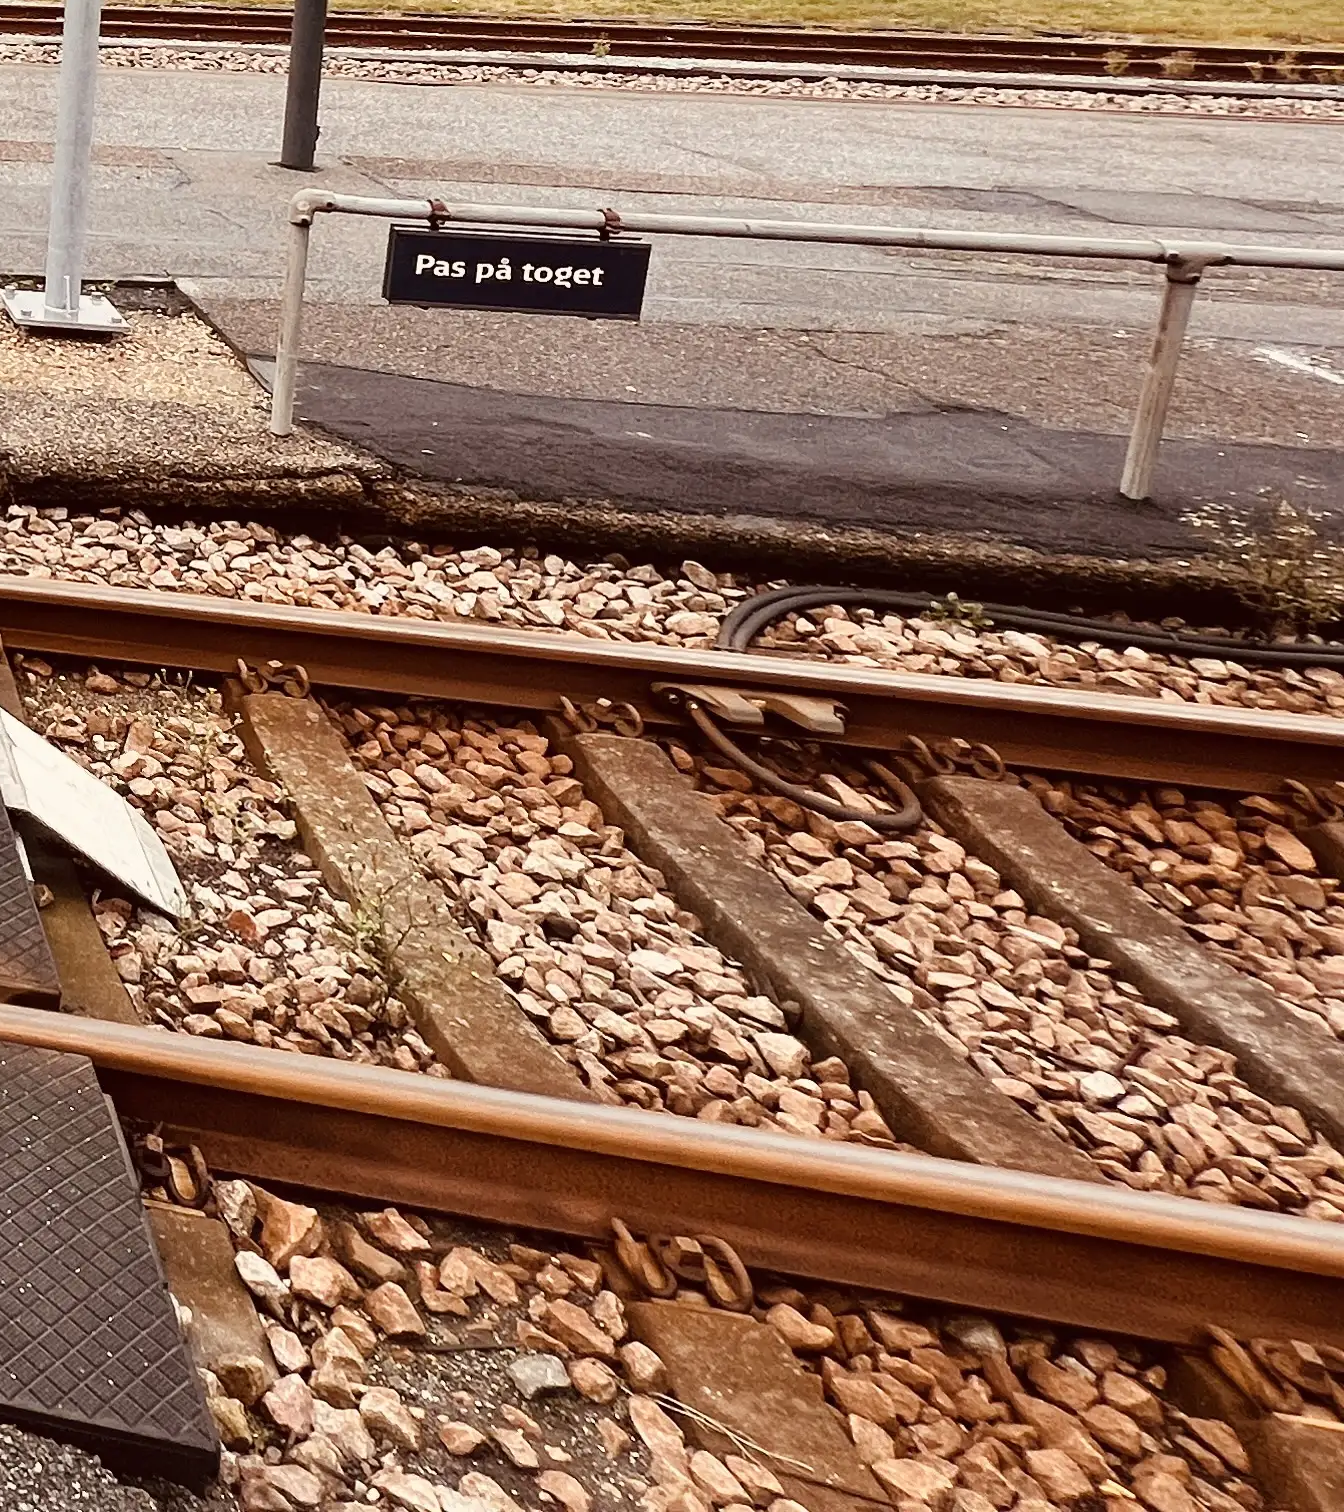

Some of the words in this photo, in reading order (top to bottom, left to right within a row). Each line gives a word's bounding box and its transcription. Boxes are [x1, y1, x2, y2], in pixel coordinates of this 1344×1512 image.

[415, 254, 466, 278] Pas
[475, 257, 512, 284] på
[521, 262, 605, 289] toget
